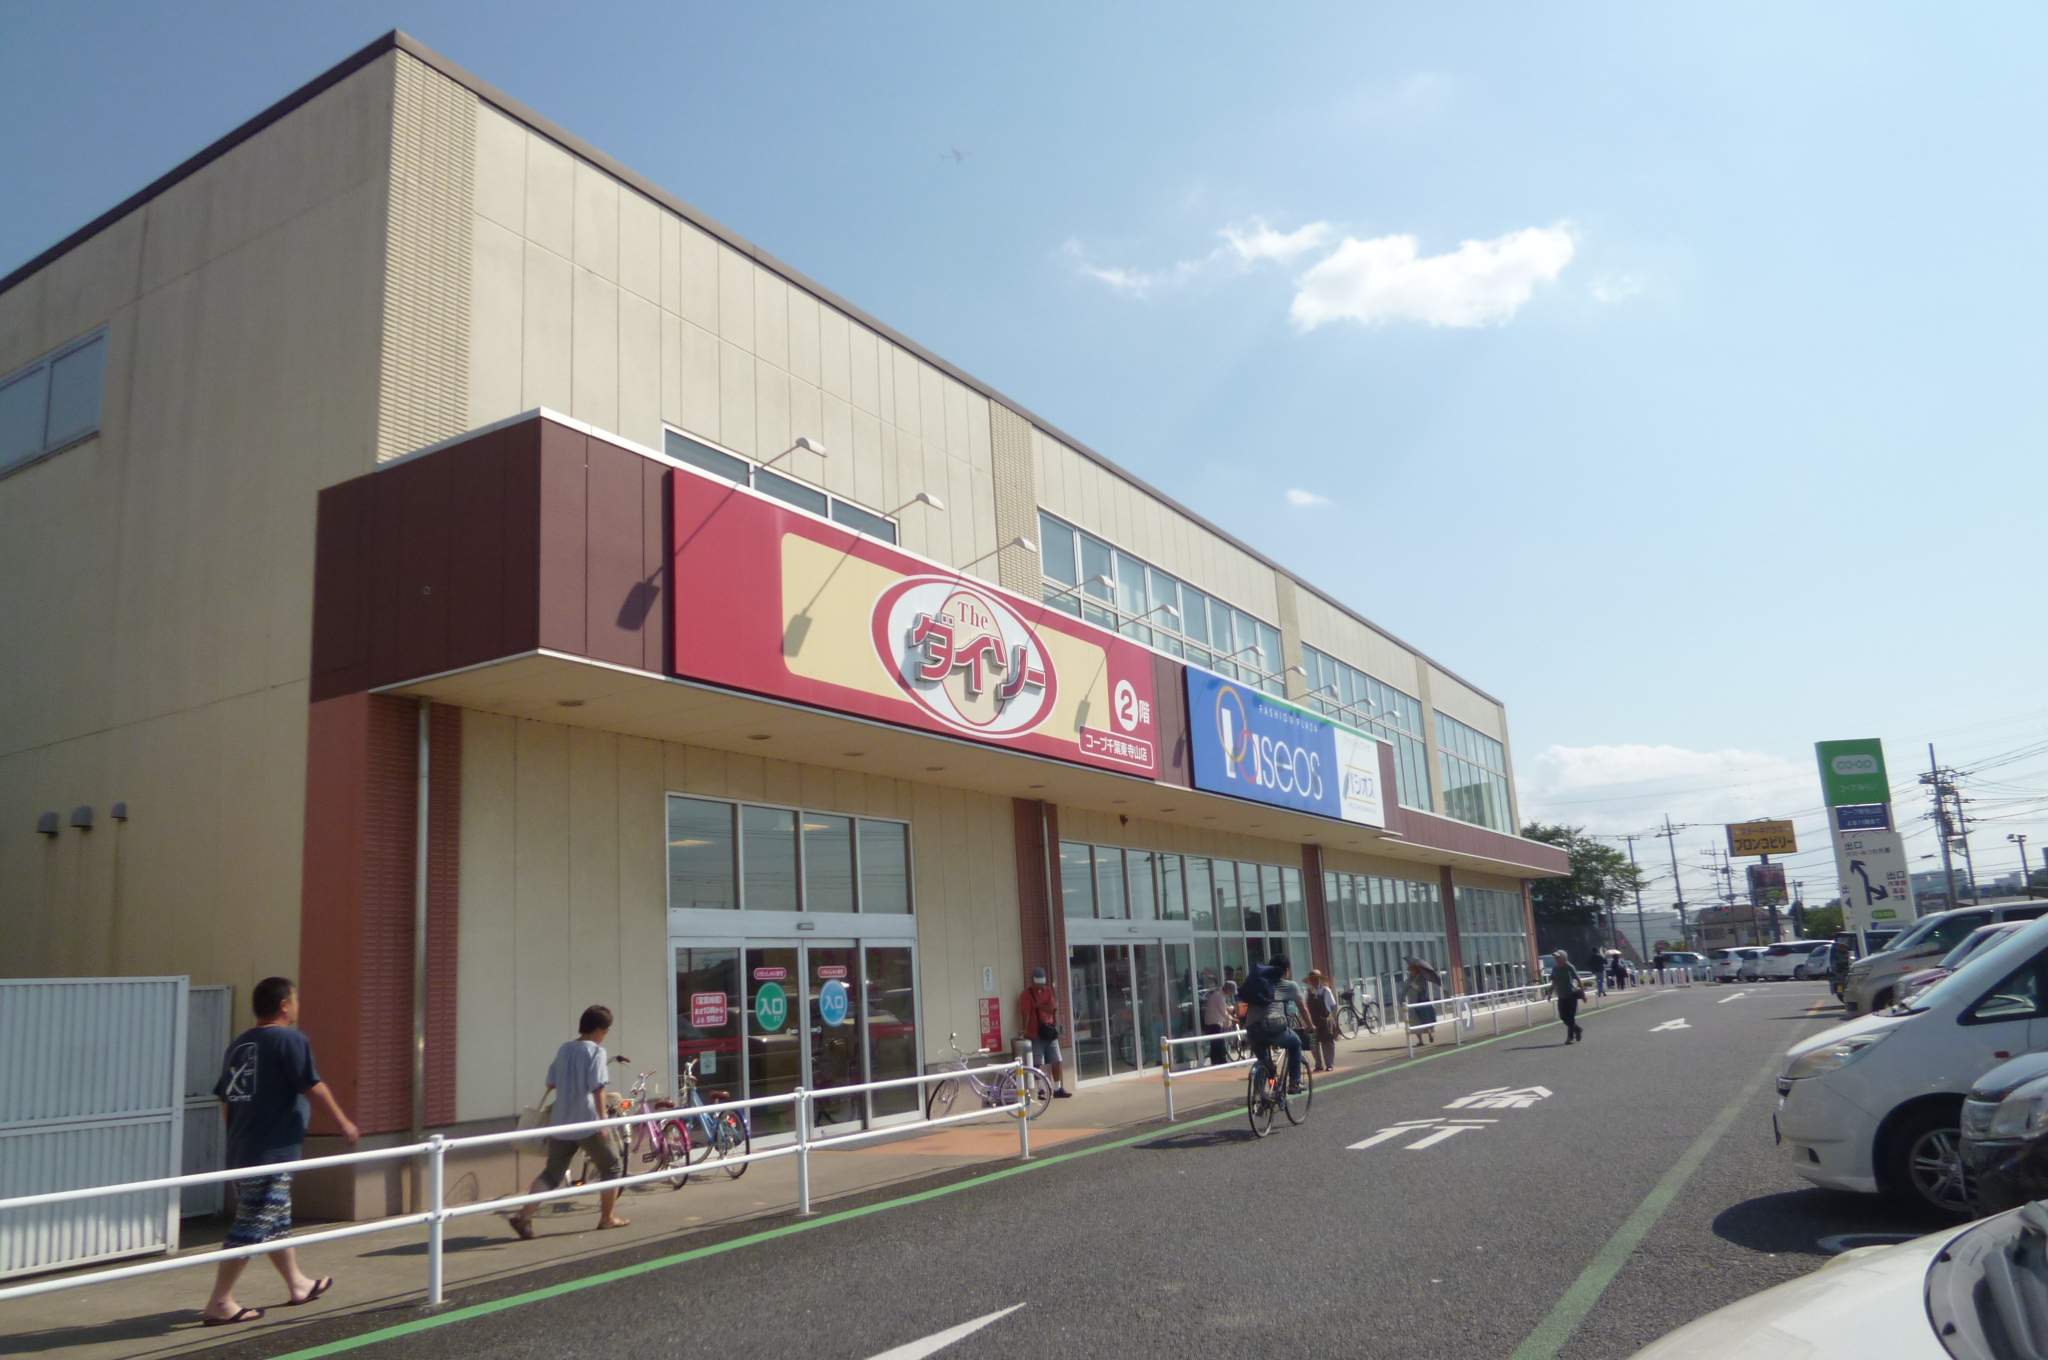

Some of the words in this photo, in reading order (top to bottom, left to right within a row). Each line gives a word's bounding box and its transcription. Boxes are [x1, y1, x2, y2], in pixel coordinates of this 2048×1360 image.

[957, 601, 989, 630] The
[909, 613, 1046, 701] ダイソー
[1118, 685, 1150, 727] 2階
[1259, 704, 1294, 725] FASHION
[1296, 718, 1319, 733] PLAZA
[1085, 733, 1148, 762] コープ千葉東寺山店
[1734, 835, 1794, 852] ブロンコビリー
[1844, 841, 1863, 851] 出口
[1886, 871, 1906, 881] 出口
[760, 997, 784, 1016] 入口
[825, 996, 843, 1010] 入口
[1344, 1085, 1554, 1151] 徐行
